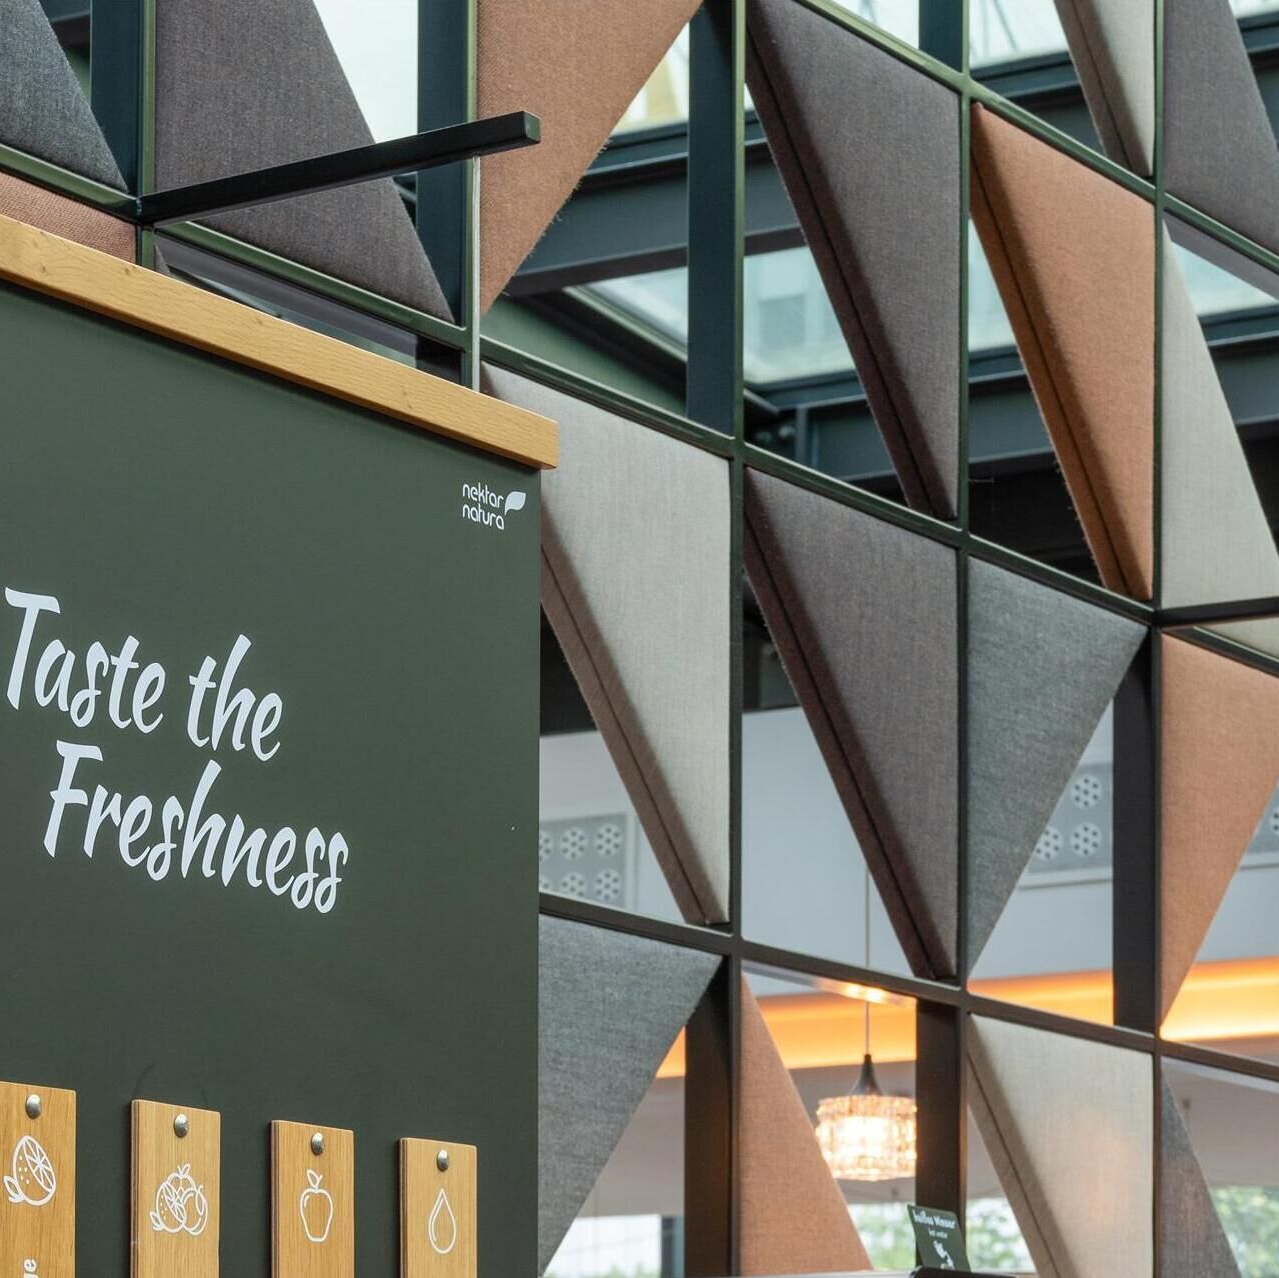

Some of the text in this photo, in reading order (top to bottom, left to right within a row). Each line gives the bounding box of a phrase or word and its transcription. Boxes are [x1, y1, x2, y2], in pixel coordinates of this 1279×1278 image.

[462, 482, 504, 508] nektar
[462, 503, 505, 530] natura
[5, 586, 283, 762] Taste the
[43, 740, 349, 914] Freshness
